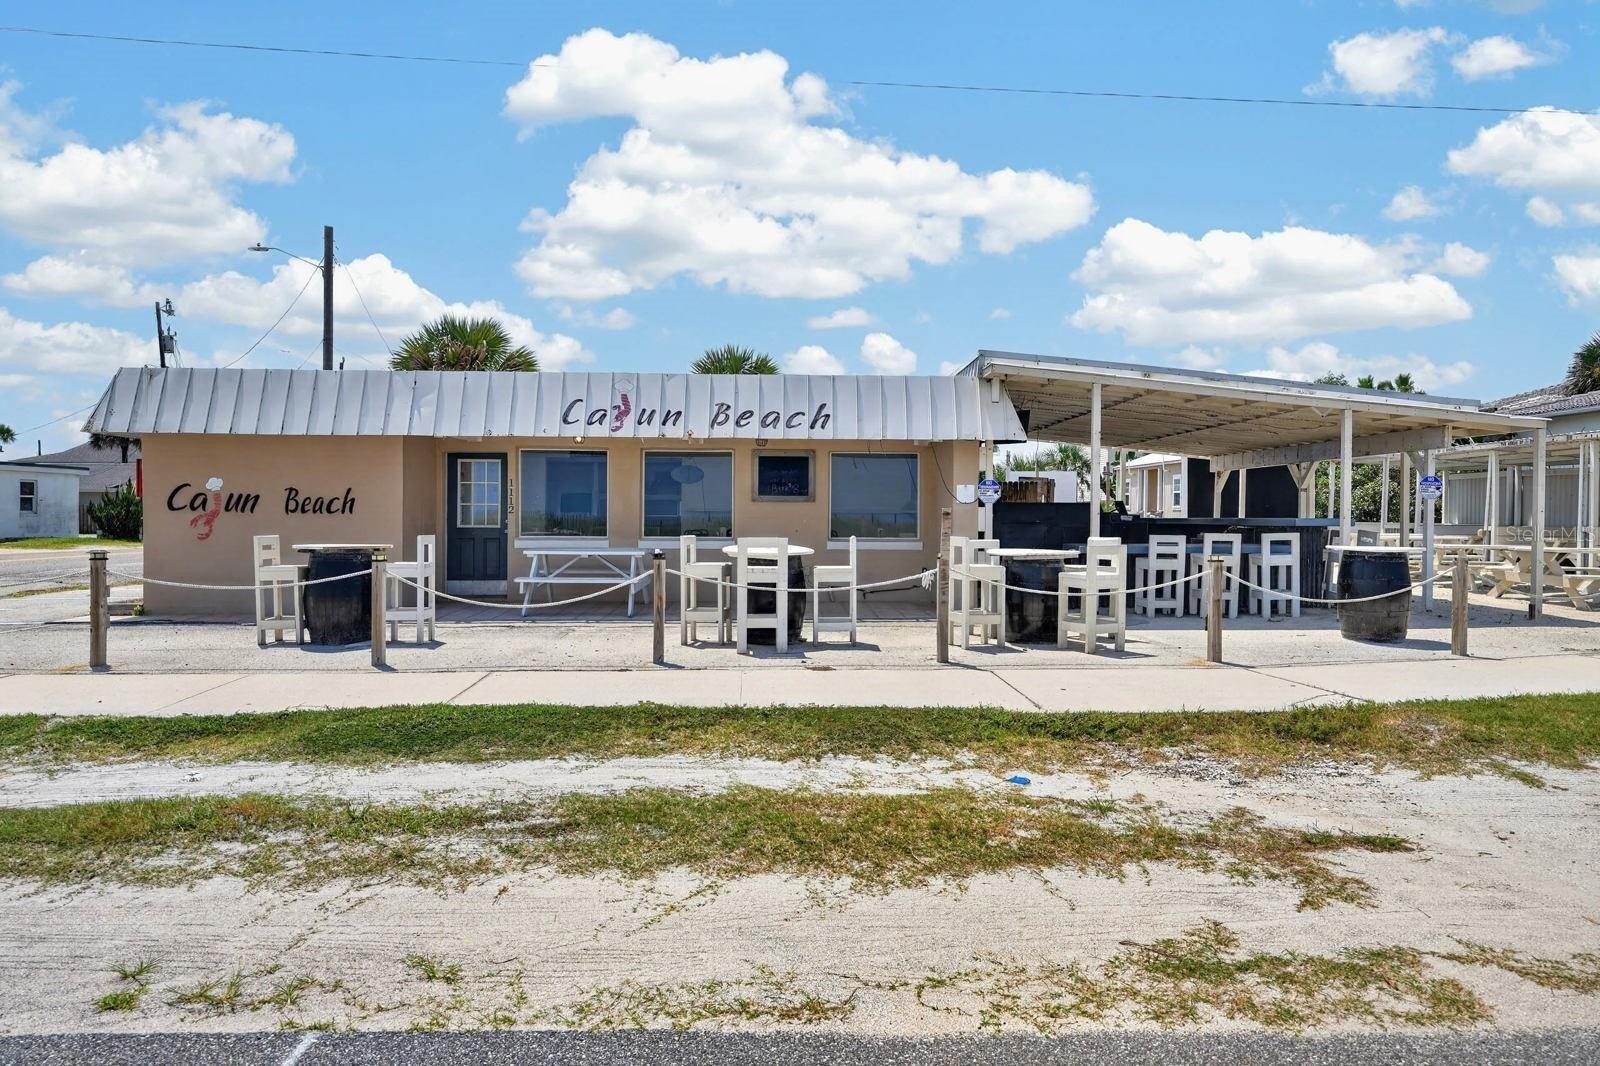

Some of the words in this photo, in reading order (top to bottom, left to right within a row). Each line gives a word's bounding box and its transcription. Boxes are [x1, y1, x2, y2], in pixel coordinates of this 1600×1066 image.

[562, 393, 683, 432] Cajun
[710, 402, 831, 430] Beach
[167, 481, 260, 540] Cajun
[284, 486, 355, 515] Beach
